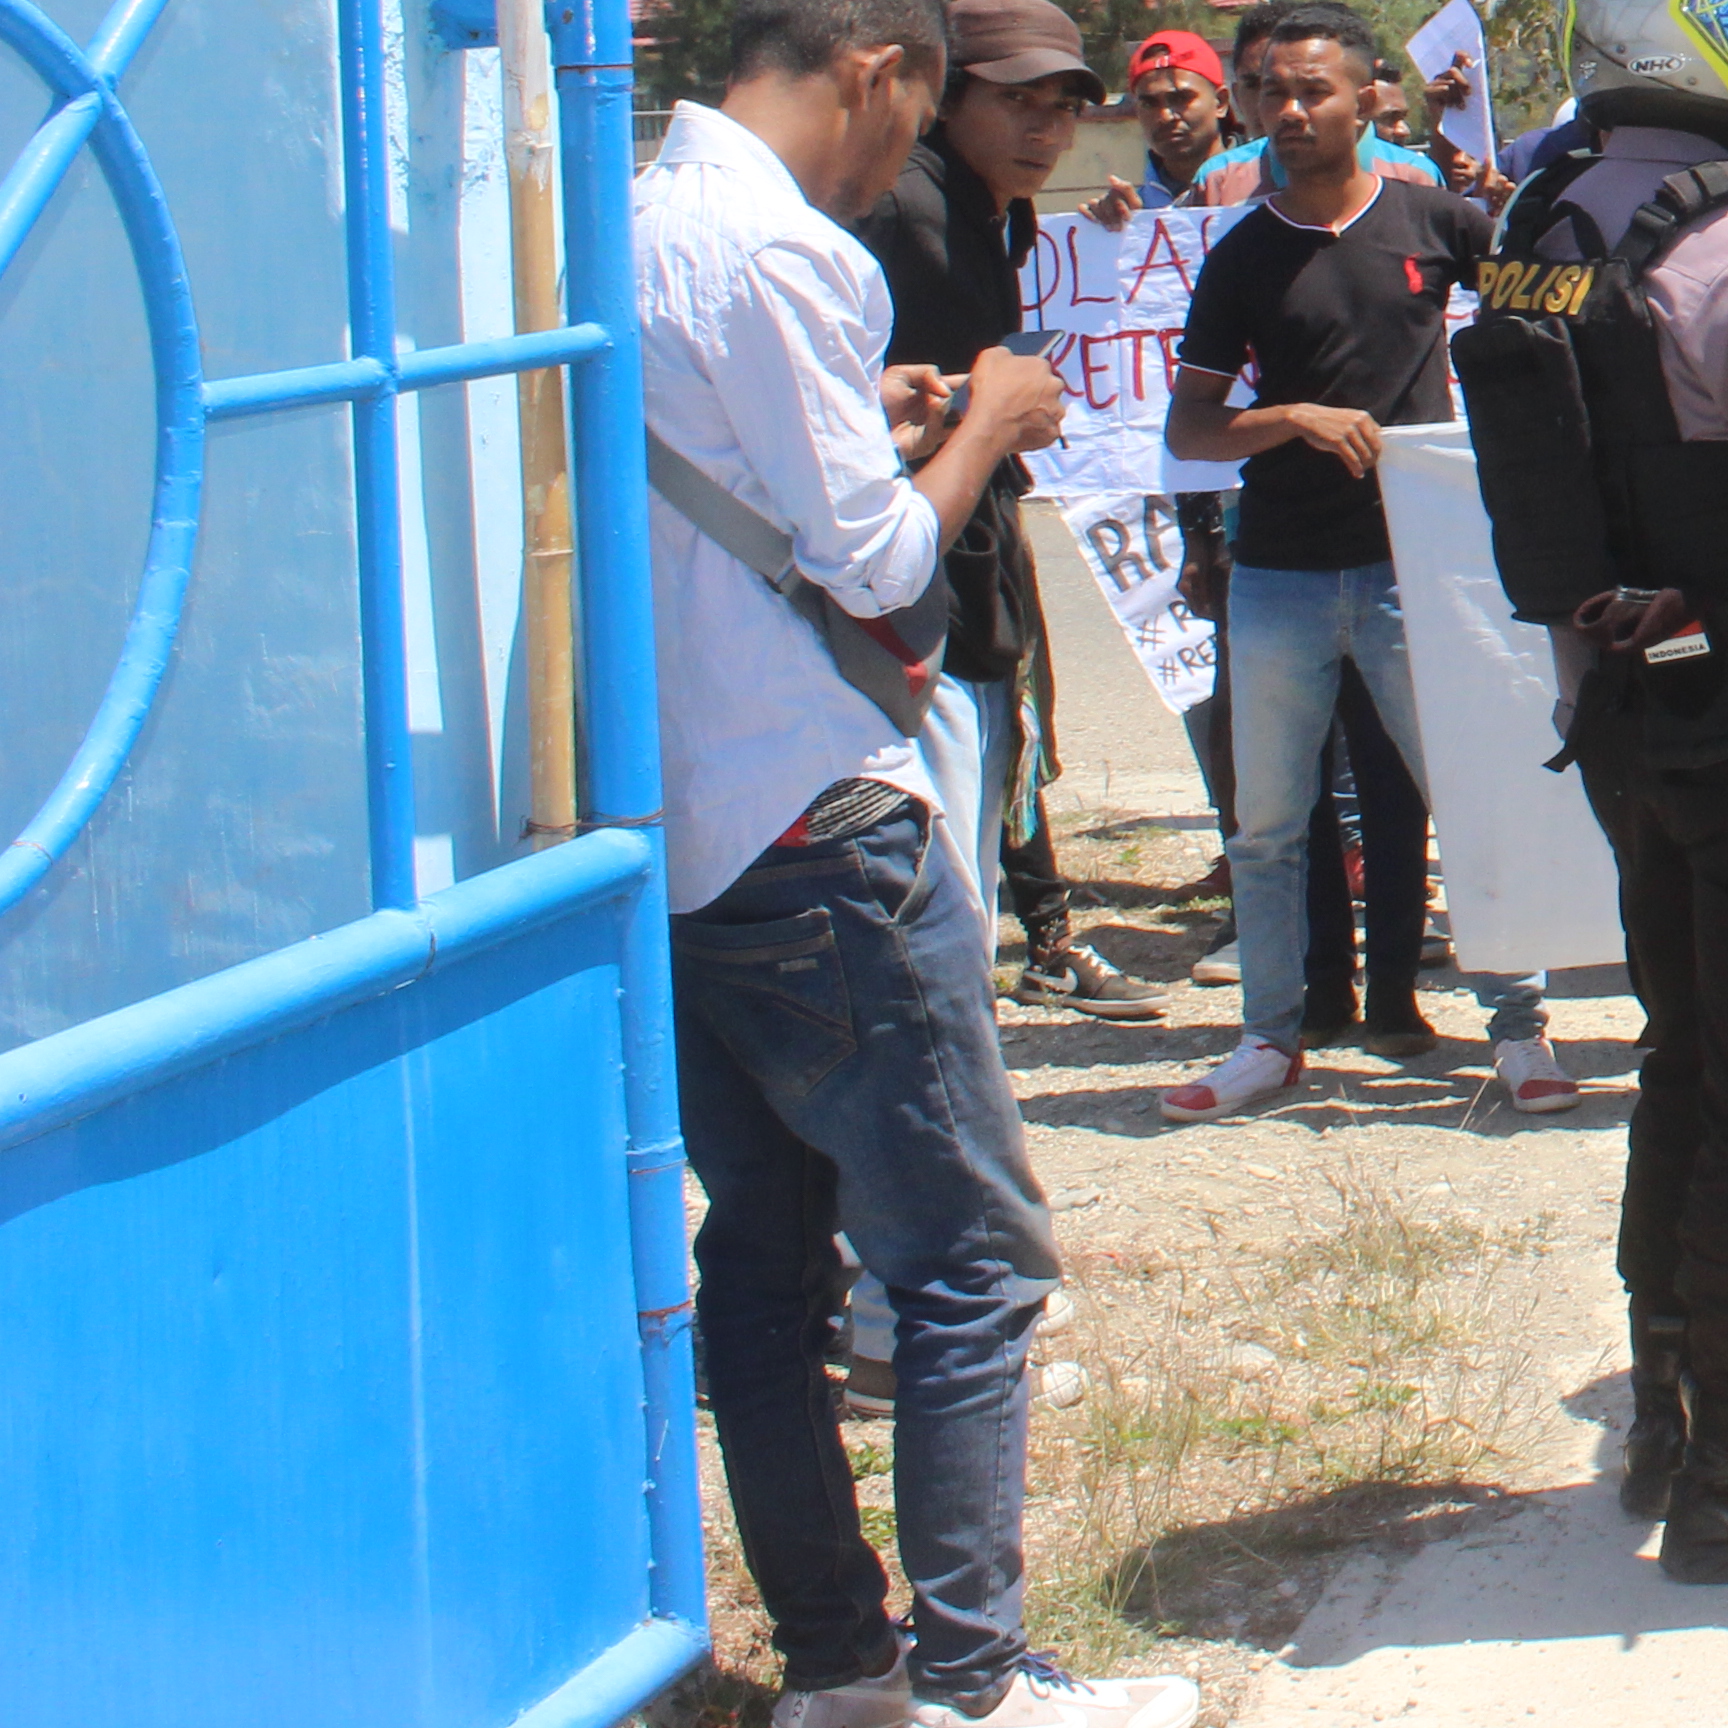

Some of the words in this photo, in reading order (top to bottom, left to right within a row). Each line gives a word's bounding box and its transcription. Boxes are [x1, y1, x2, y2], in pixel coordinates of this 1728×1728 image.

[1633, 57, 1674, 74] NHK
[1478, 260, 1595, 316] POLISI
[1647, 643, 1707, 660] INDONESIA
